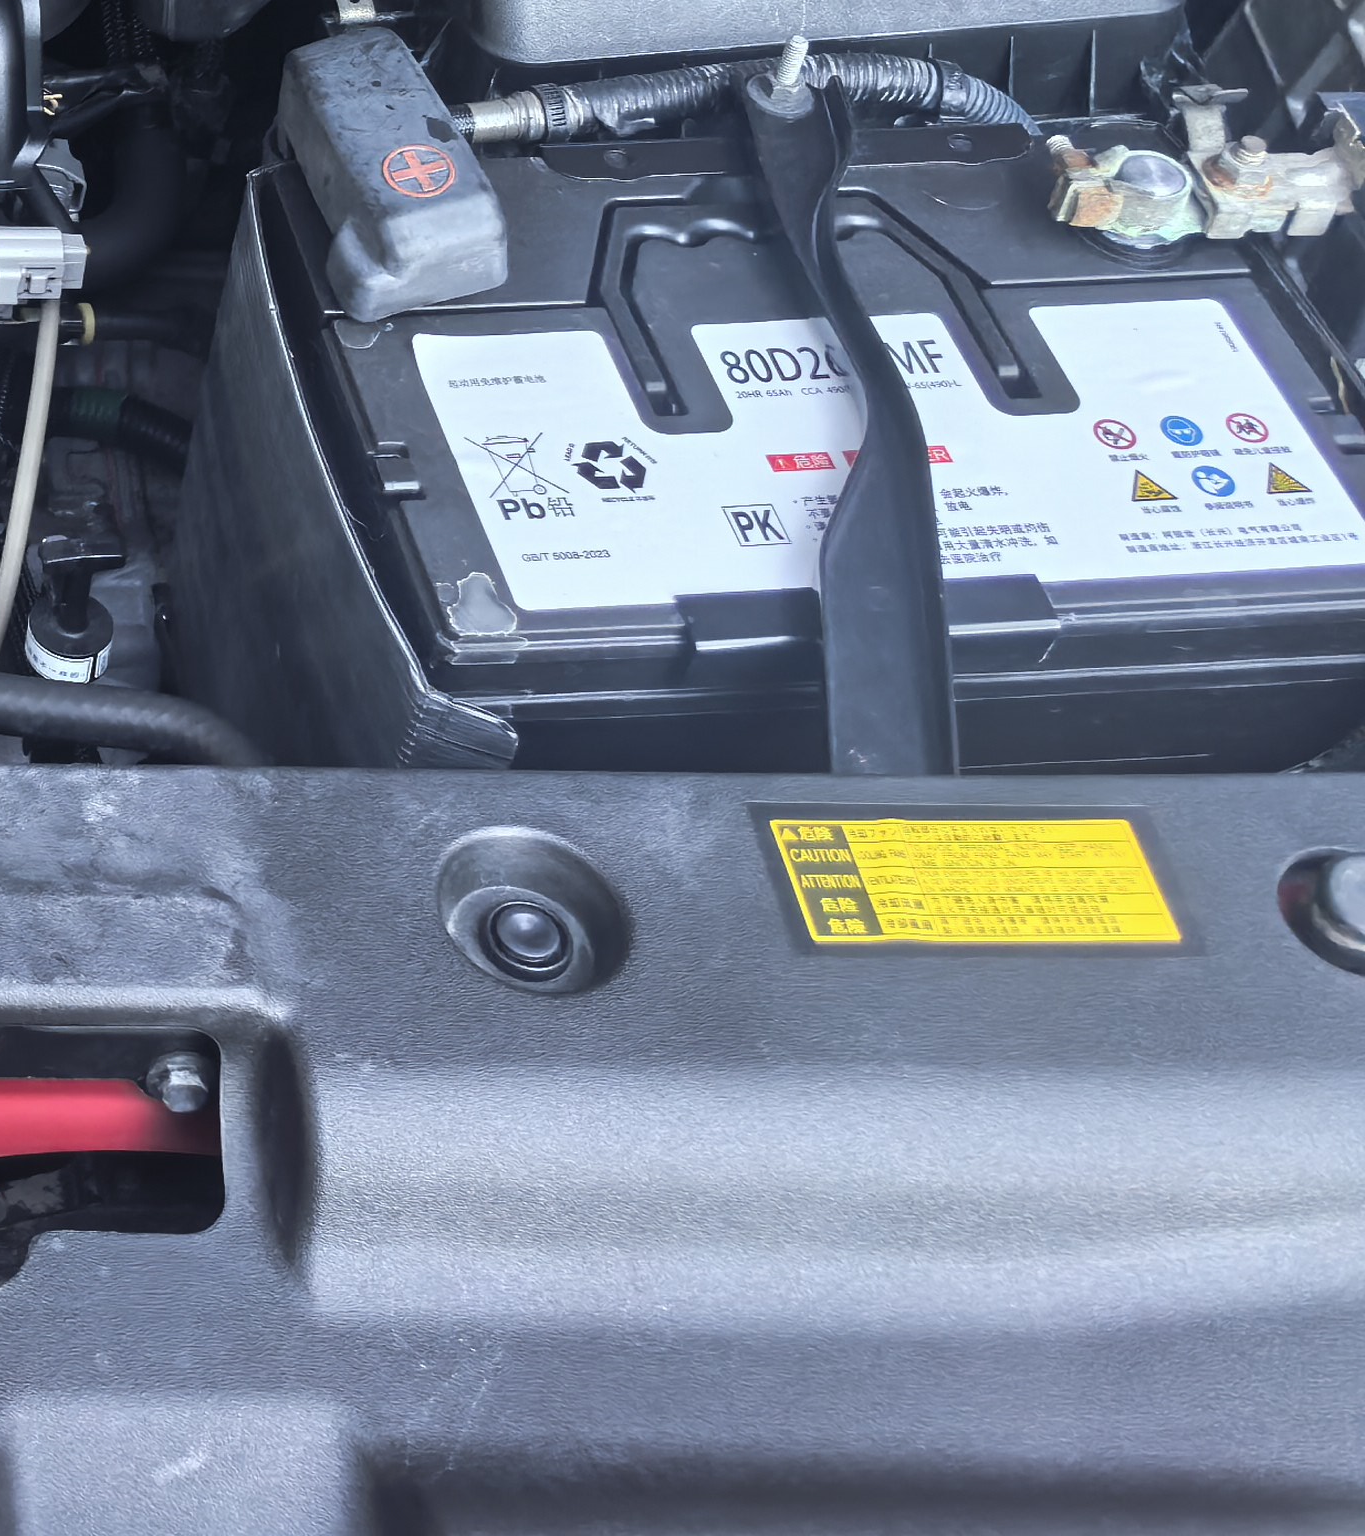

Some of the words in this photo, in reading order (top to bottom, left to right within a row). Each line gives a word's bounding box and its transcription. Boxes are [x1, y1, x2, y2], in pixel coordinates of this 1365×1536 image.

[801, 387, 823, 395] CCA
[792, 455, 833, 469] 危险
[496, 498, 546, 520] Pb
[731, 509, 785, 542] PK
[521, 552, 550, 562] GB/T
[552, 550, 611, 561] 5008-2023
[789, 848, 852, 863] CAUTION
[800, 874, 862, 889] ATTENTION
